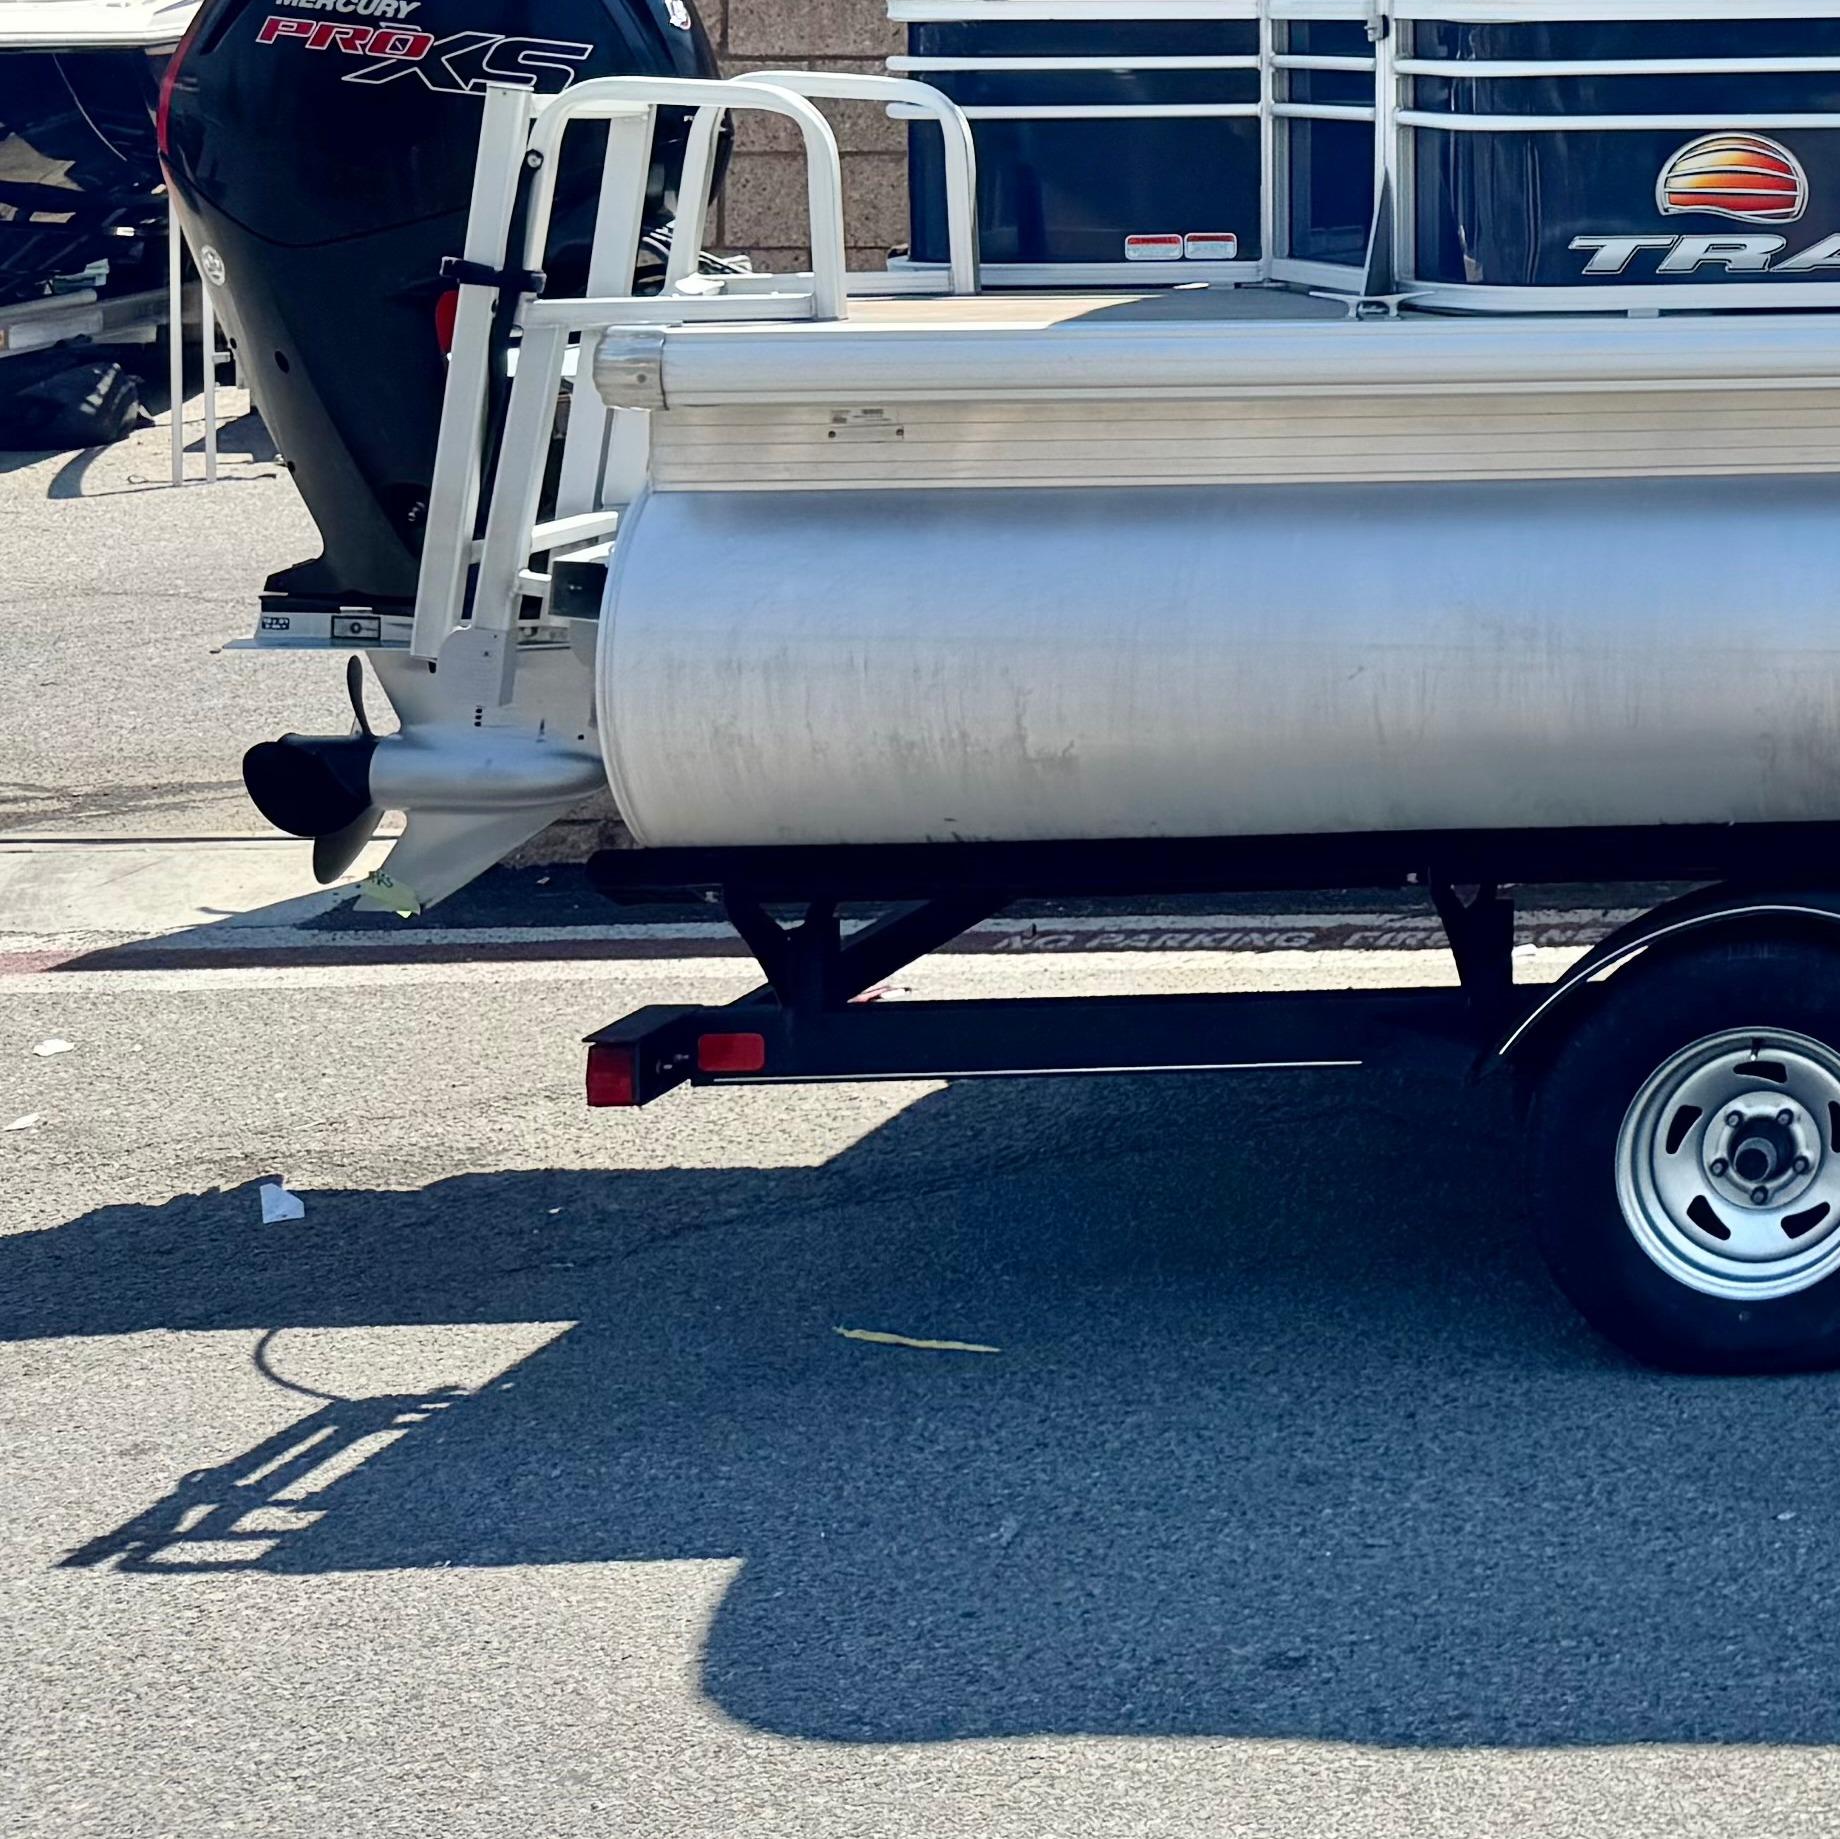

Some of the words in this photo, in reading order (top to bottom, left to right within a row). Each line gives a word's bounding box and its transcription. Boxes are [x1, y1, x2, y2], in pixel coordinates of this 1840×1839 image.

[255, 15, 435, 61] PRO
[341, 30, 594, 96] XS
[993, 933, 1075, 951] NO
[1085, 931, 1317, 949] PARKING
